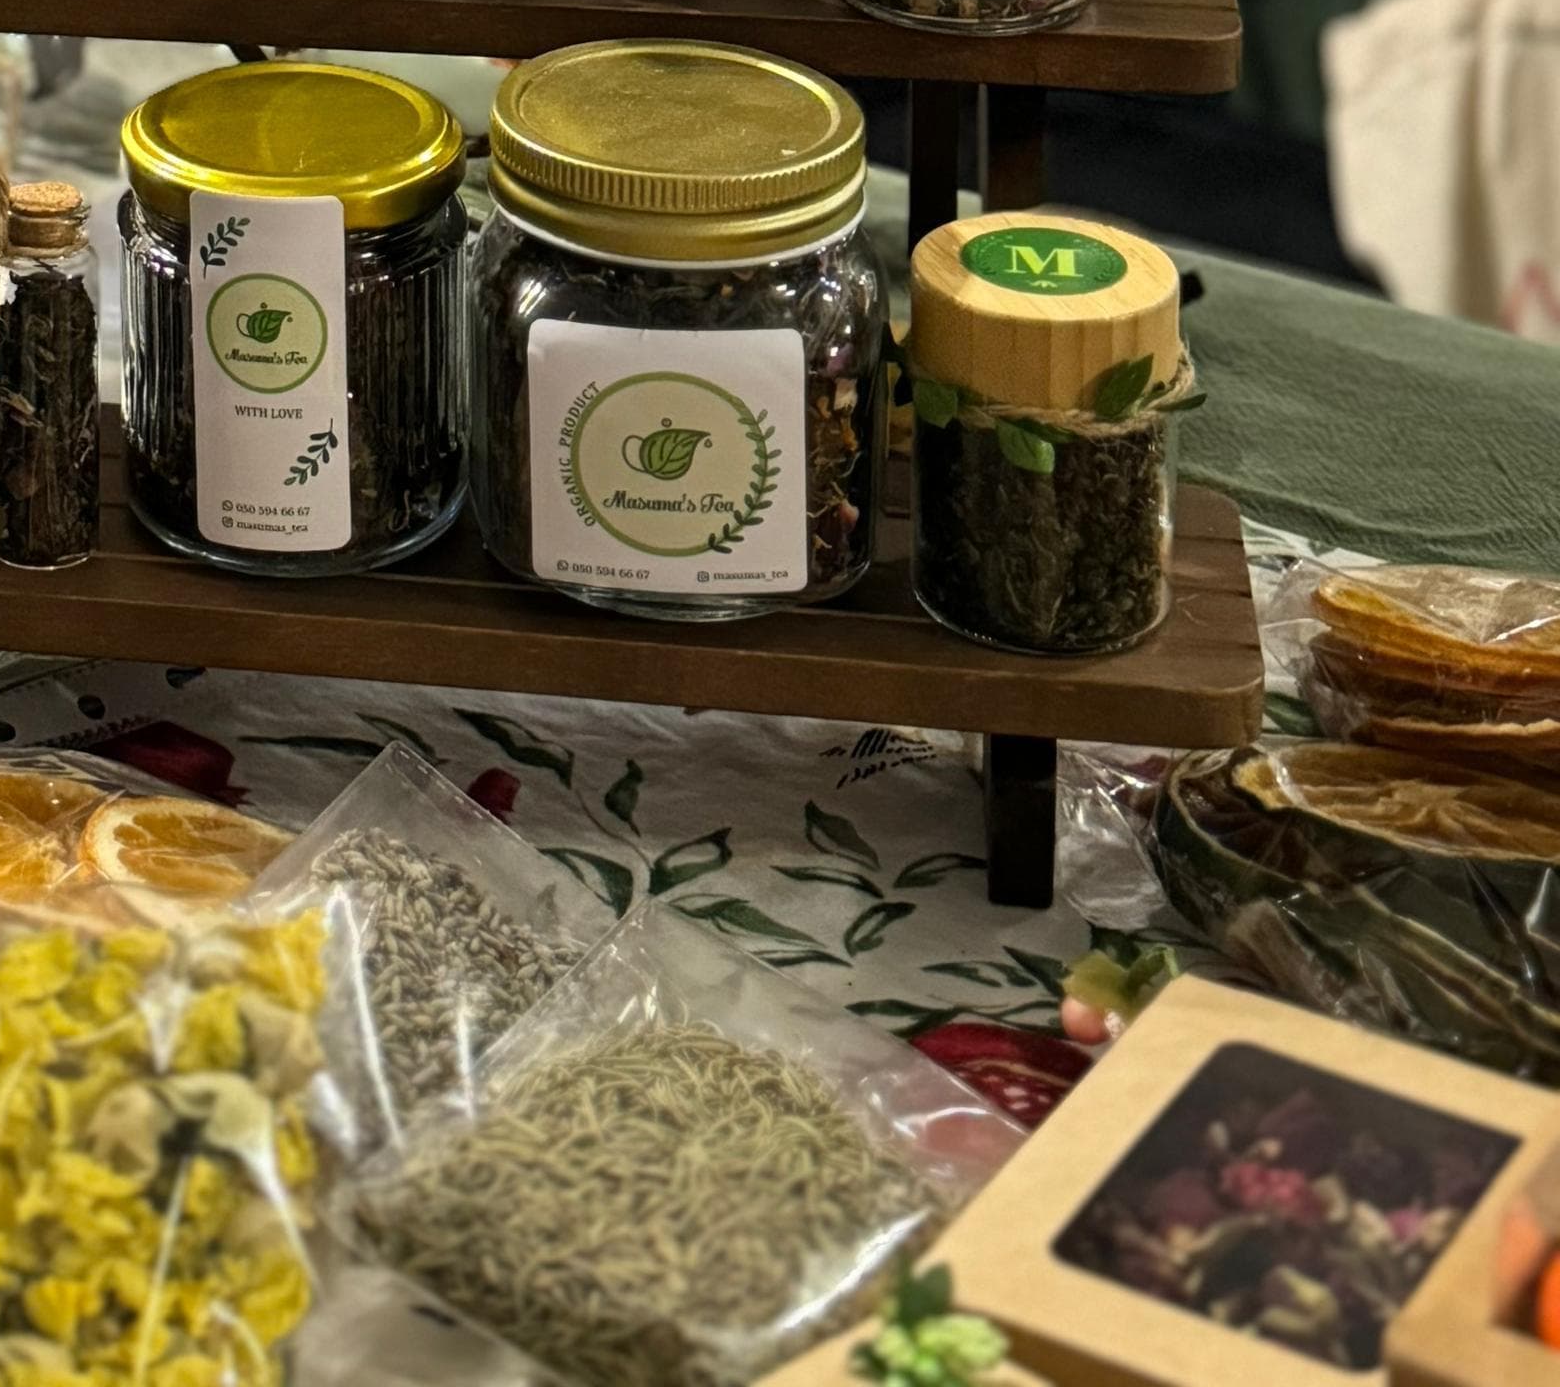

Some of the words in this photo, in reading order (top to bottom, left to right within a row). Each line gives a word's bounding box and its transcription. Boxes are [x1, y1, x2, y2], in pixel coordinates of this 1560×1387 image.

[1003, 245, 1084, 277] M
[284, 351, 308, 365] Tea
[234, 405, 268, 418] WITH
[271, 407, 303, 420] LOVE
[559, 381, 602, 448] PRODUCT
[559, 457, 596, 527] ORGANIC
[602, 490, 697, 514] Masuma's
[700, 493, 737, 514] Tea
[572, 563, 593, 574] 050
[595, 565, 616, 577] 594
[618, 568, 634, 578] 66
[636, 569, 651, 580] 67
